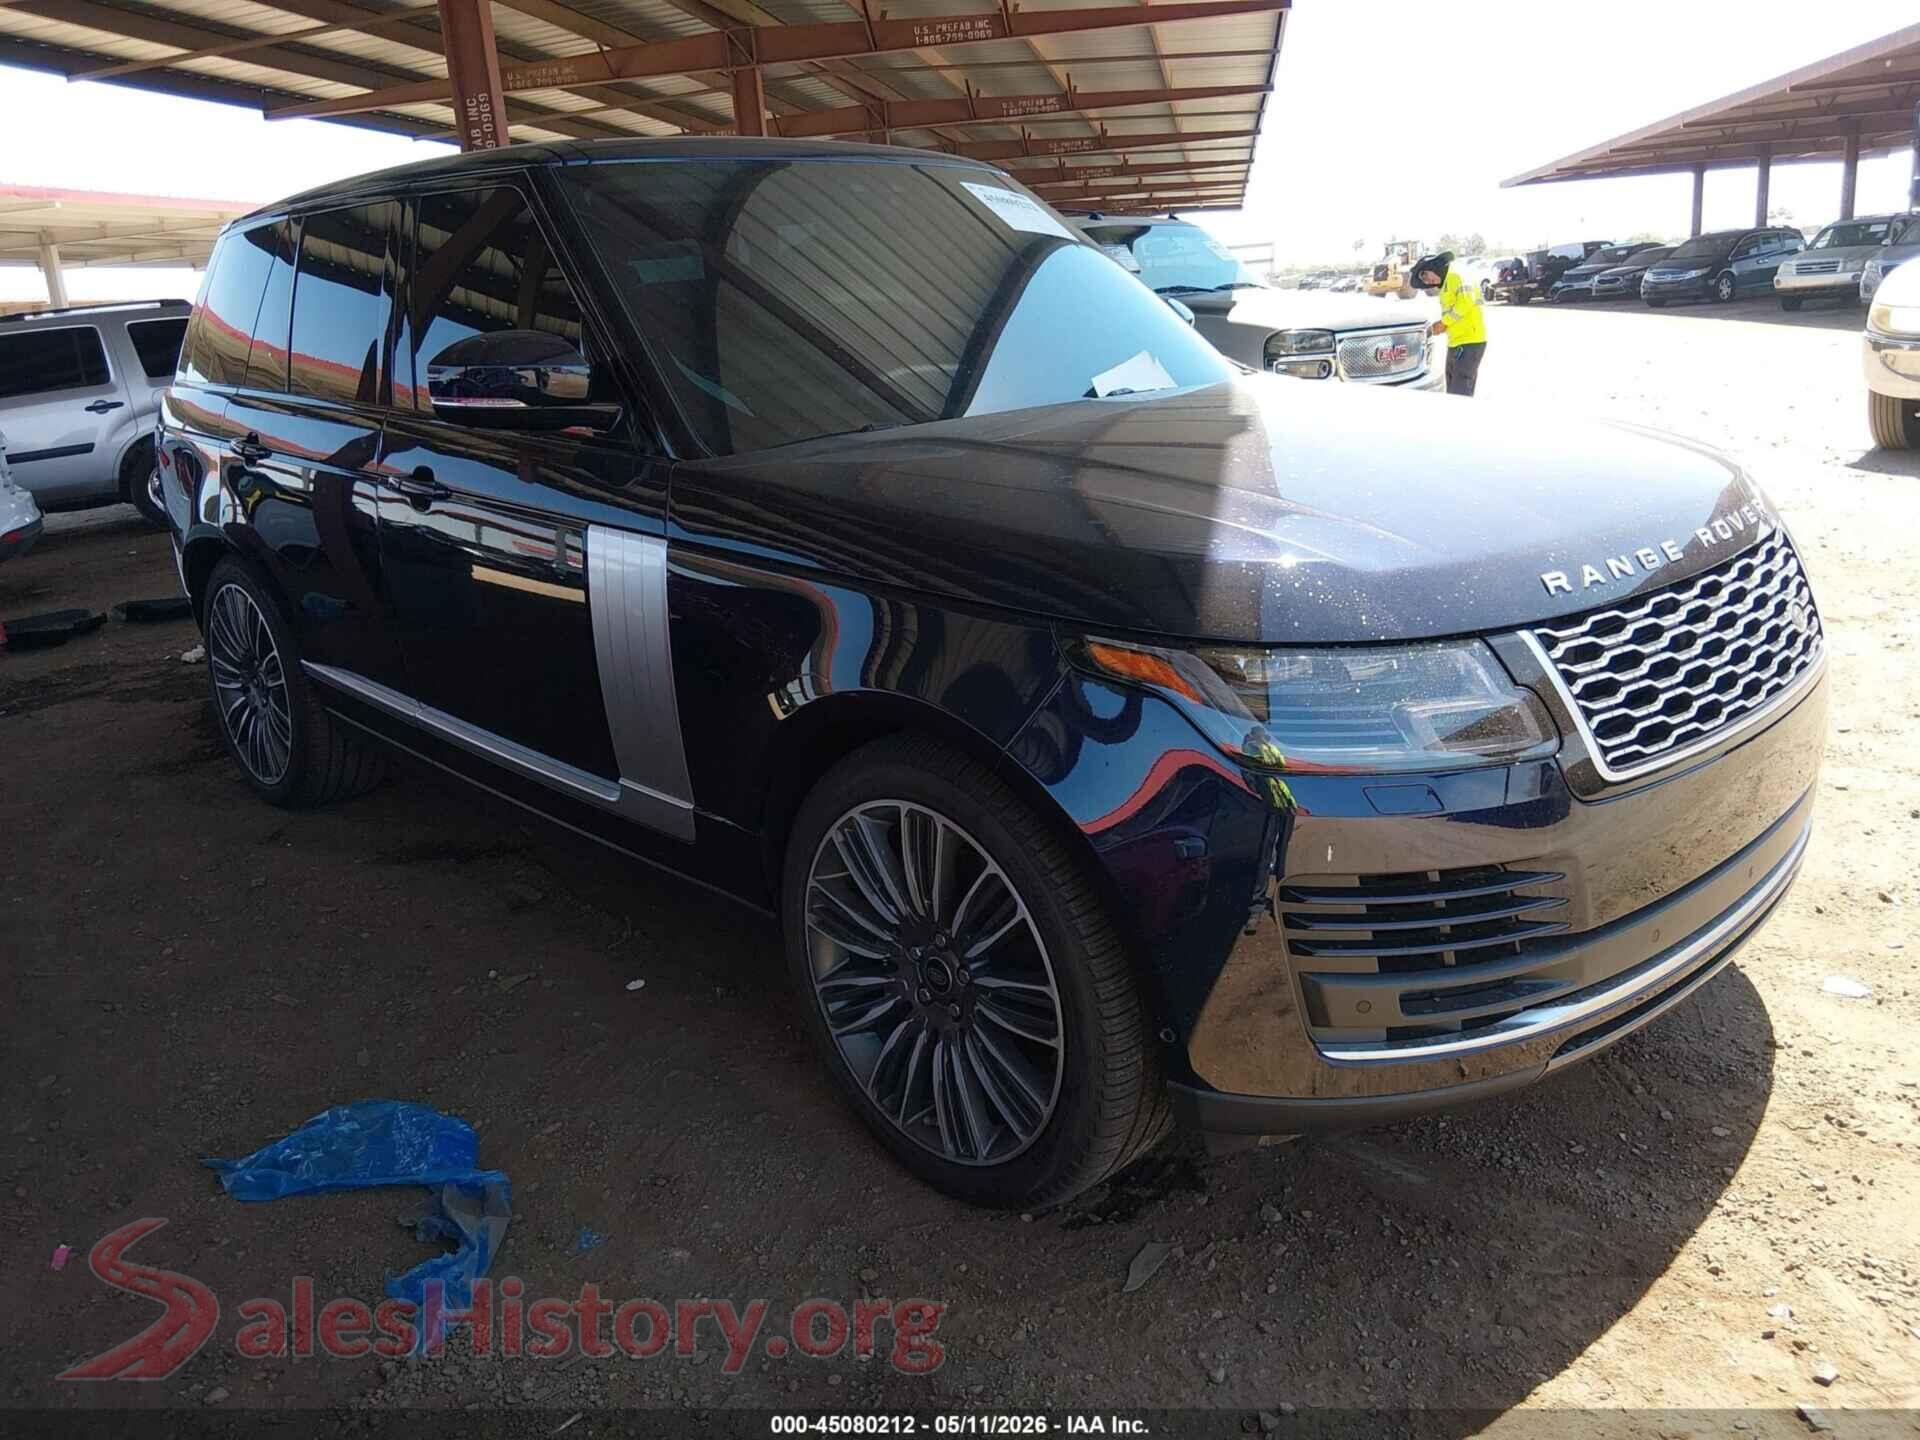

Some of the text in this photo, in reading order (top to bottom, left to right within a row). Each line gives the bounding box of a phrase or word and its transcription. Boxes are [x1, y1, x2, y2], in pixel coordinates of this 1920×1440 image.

[936, 22, 971, 33] PREFAB
[1376, 344, 1409, 361] GMC
[1540, 498, 1769, 596] RANGE ROVER
